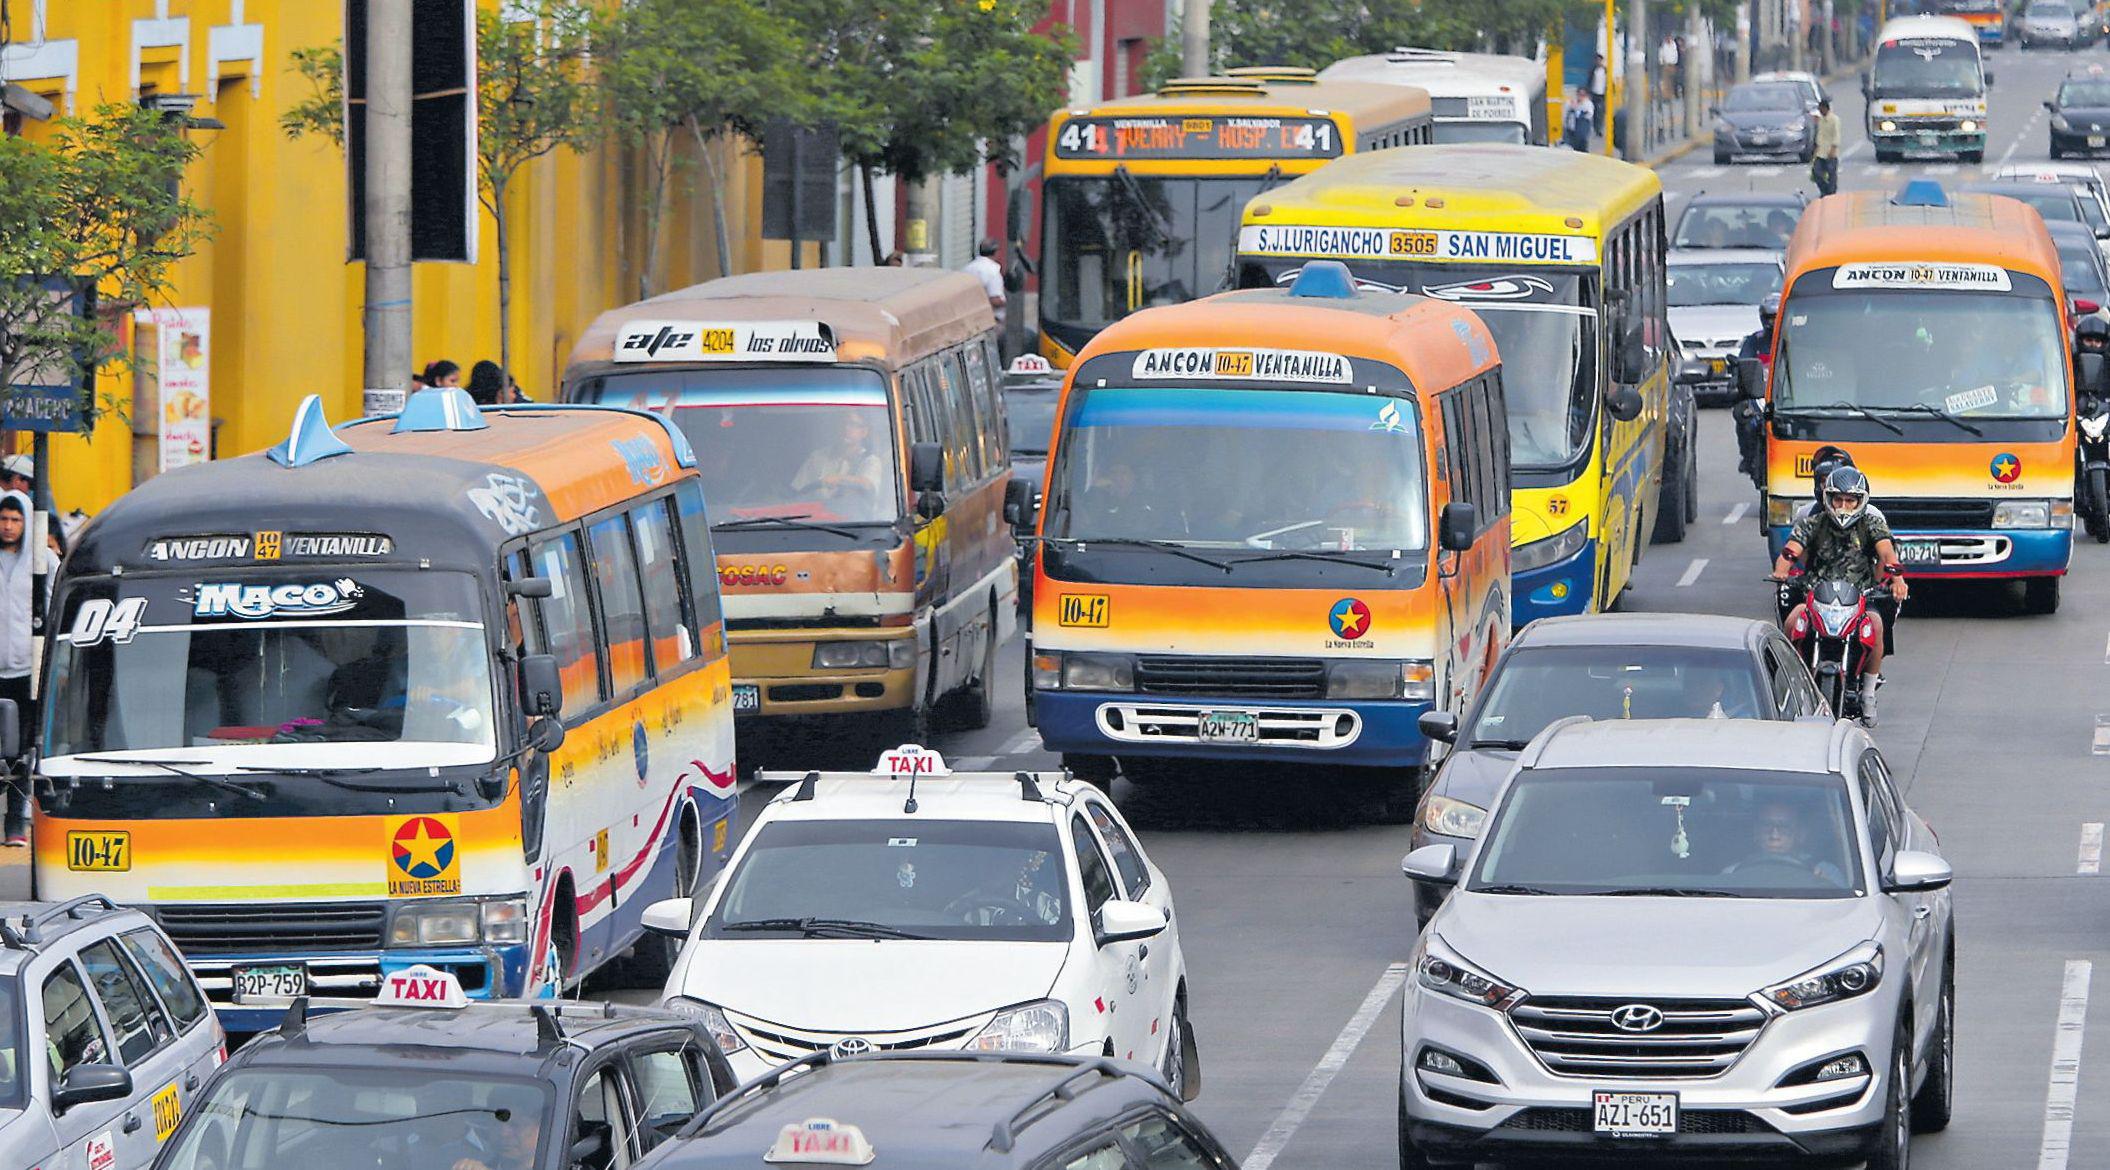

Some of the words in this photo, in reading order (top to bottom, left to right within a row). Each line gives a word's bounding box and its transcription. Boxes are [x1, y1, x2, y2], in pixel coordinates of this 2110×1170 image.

[1060, 123, 1096, 151] 41
[1295, 124, 1331, 151] 41
[1258, 228, 1383, 254] S.J.LURIGANCHO
[1393, 237, 1434, 253] 3505
[1448, 234, 1489, 256] SAN
[1496, 236, 1573, 260] MIGUEL
[1847, 269, 1905, 281] ANCON
[1938, 270, 1998, 283] VENTANILLA
[703, 331, 735, 350] 4204
[1145, 351, 1214, 374] ANCON
[1217, 355, 1250, 373] 10-47
[1255, 354, 1344, 380] VENTANILLA
[1550, 500, 1567, 514] 57
[150, 539, 250, 560] ANCON
[284, 537, 392, 555] VENTANILLA
[195, 580, 341, 618] MACO
[1063, 597, 1105, 624] 10-47
[70, 597, 148, 647] 04
[888, 756, 932, 773] TAXI
[74, 836, 125, 867] 10-47
[389, 881, 397, 894] LA
[399, 880, 421, 894] NUEVA
[423, 879, 458, 893] ESTRELLA
[237, 973, 303, 995] B2P-759
[391, 979, 447, 1000] TAXI
[1621, 1095, 1650, 1104] PERU
[1598, 1104, 1673, 1127] AZI-651
[808, 1123, 832, 1131] LIBRE
[789, 1131, 851, 1153] TAXI
